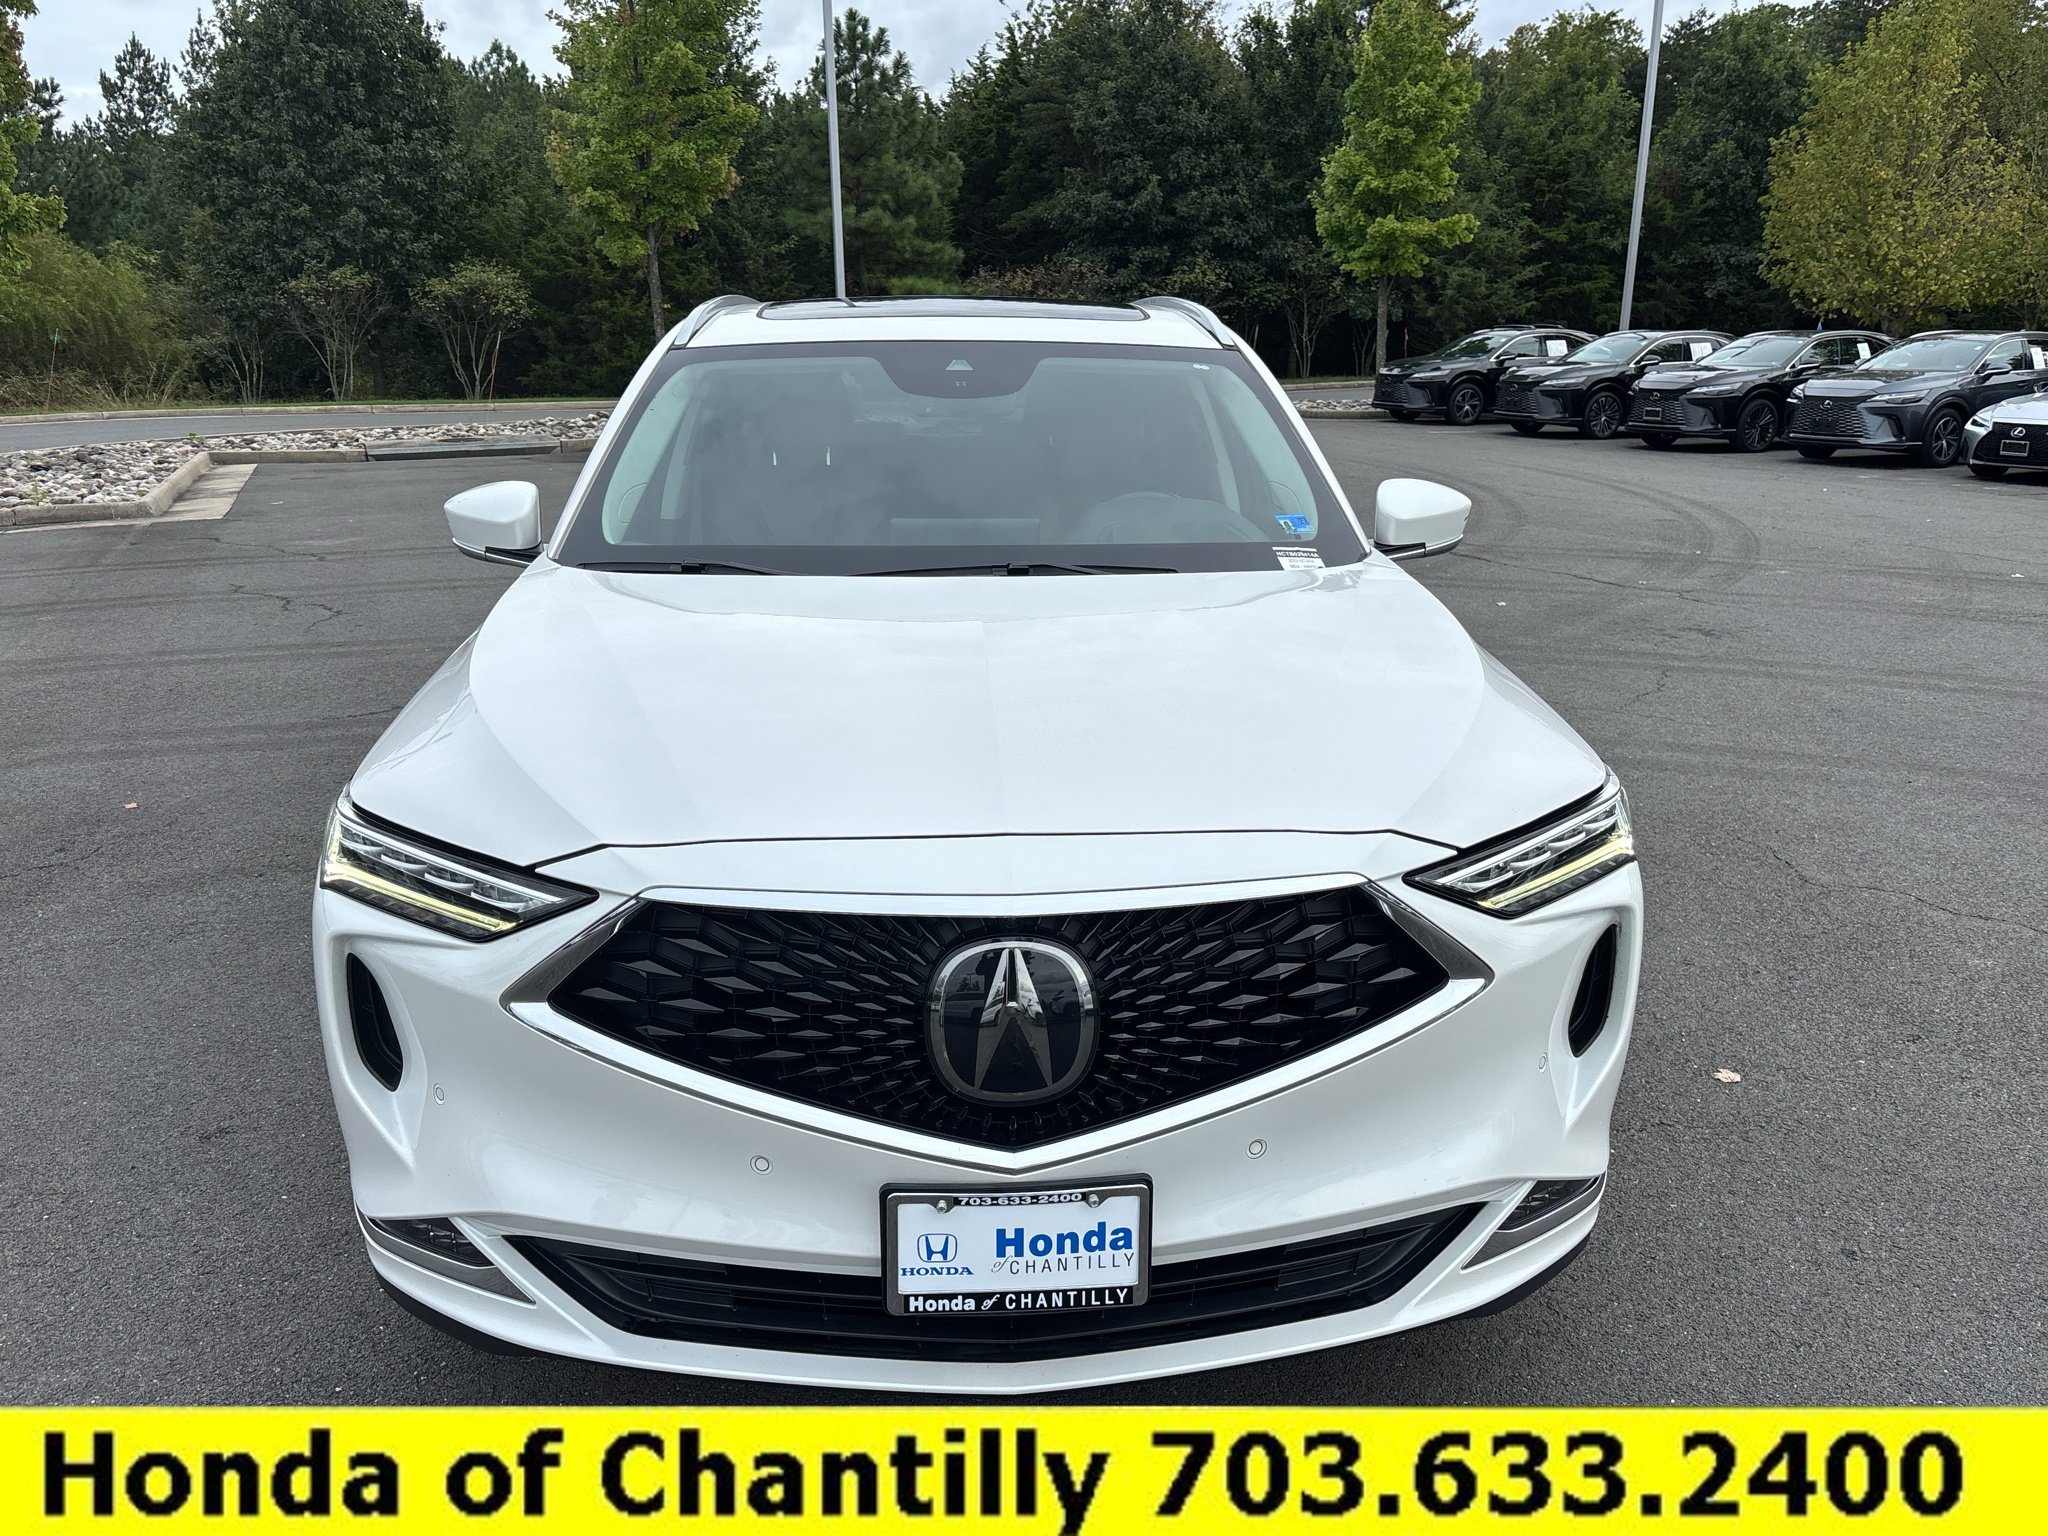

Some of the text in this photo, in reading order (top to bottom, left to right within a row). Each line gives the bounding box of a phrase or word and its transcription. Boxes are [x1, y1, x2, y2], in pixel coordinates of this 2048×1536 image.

[958, 1193, 1082, 1206] 703-633-2400
[996, 1221, 1133, 1258] Honda
[900, 1266, 974, 1276] HONDA
[991, 1252, 1135, 1274] of CHANTILLY
[909, 1288, 1128, 1312] Honda of CHANTILLY
